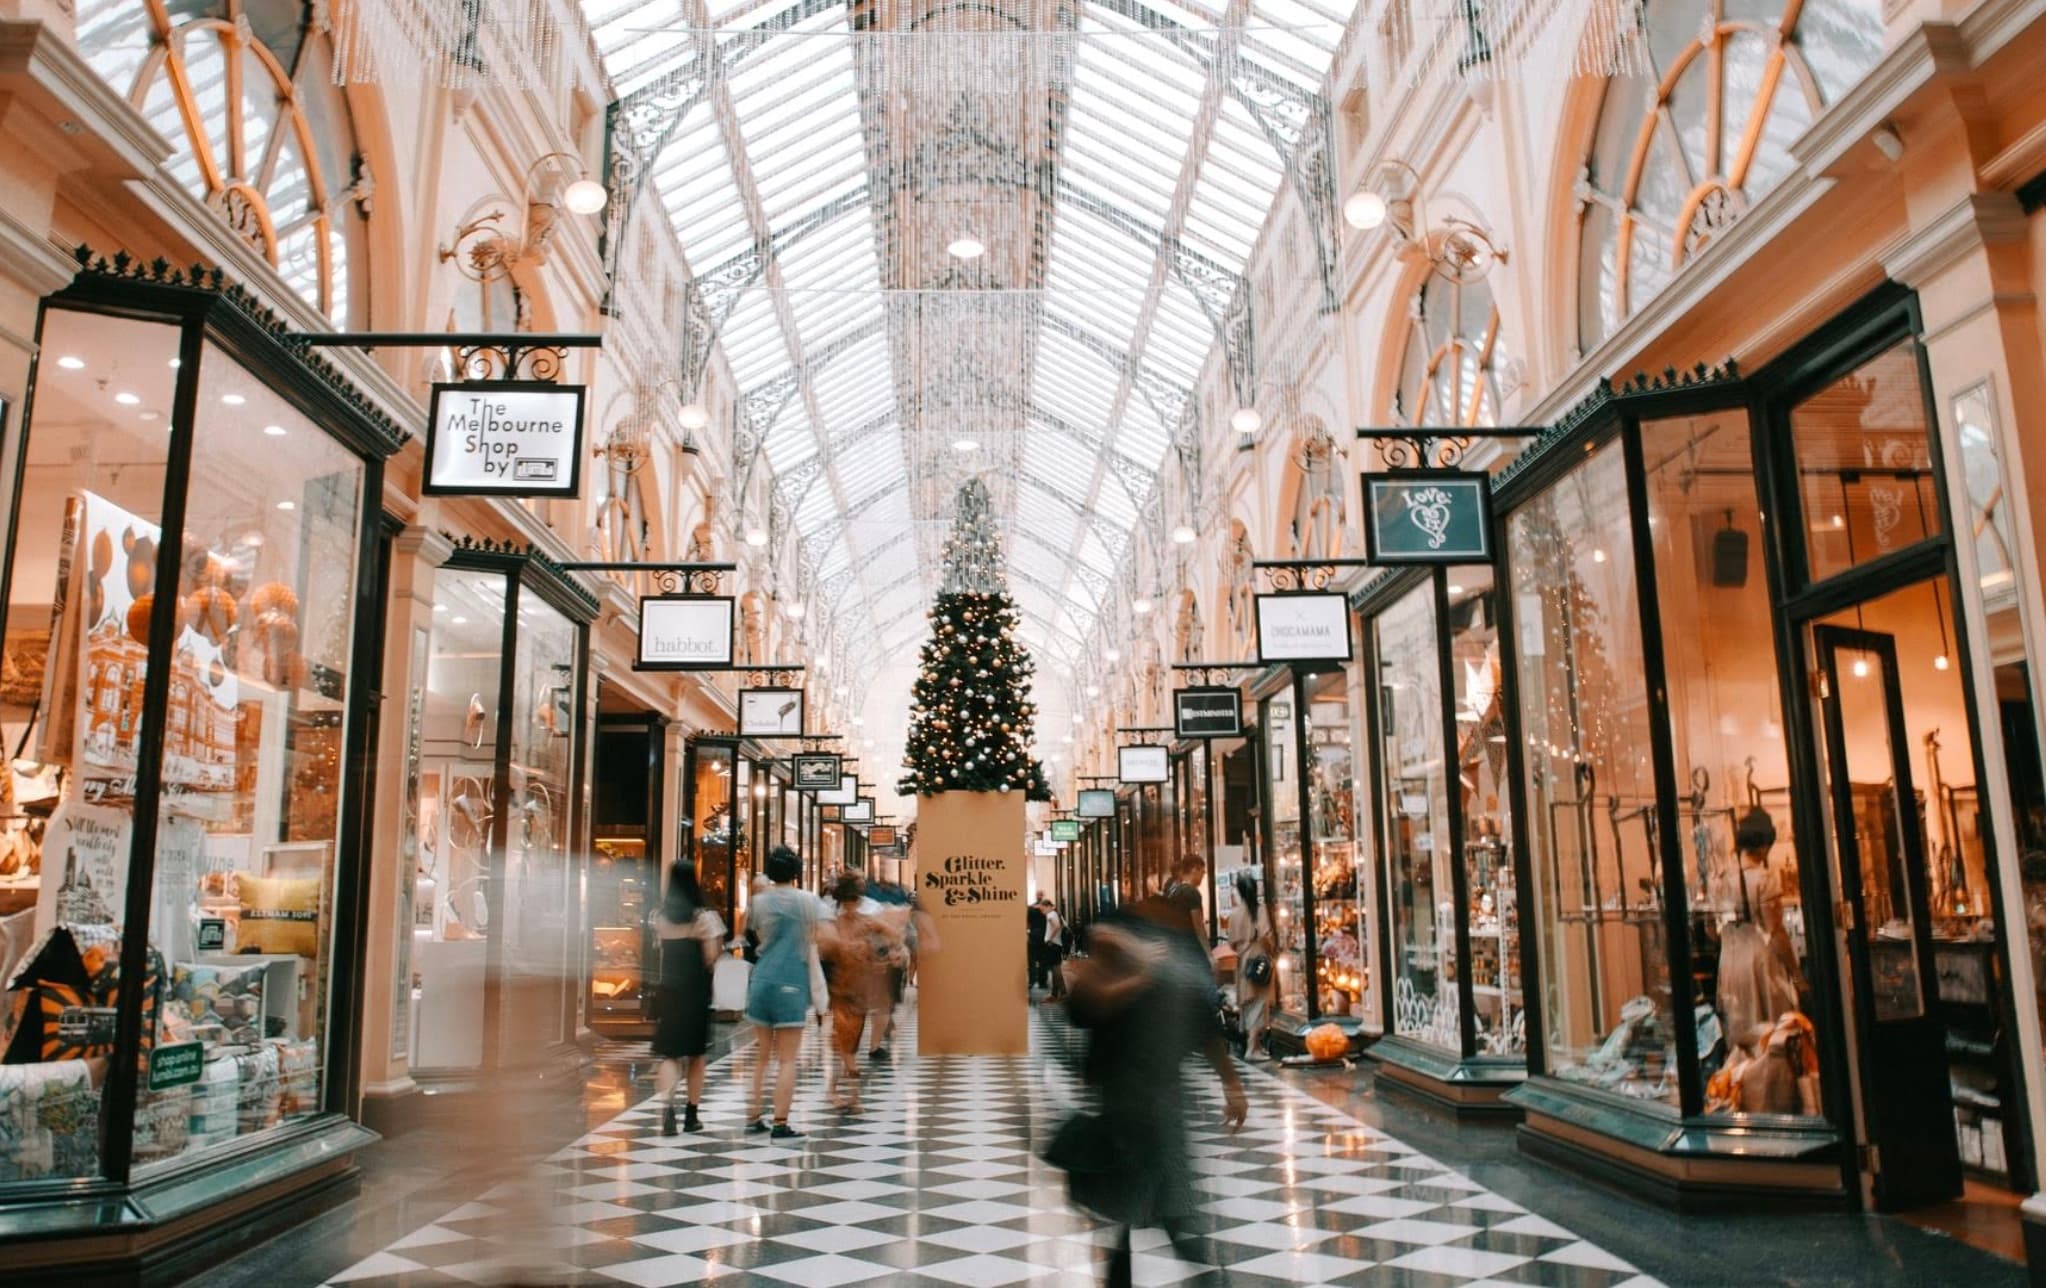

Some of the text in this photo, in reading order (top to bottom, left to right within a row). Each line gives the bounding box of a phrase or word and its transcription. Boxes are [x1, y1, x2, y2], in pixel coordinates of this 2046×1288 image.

[470, 398, 506, 416] The
[447, 414, 563, 434] Melbourne
[465, 435, 518, 459] Shop
[484, 456, 509, 478] by
[925, 872, 993, 889] Sparkle
